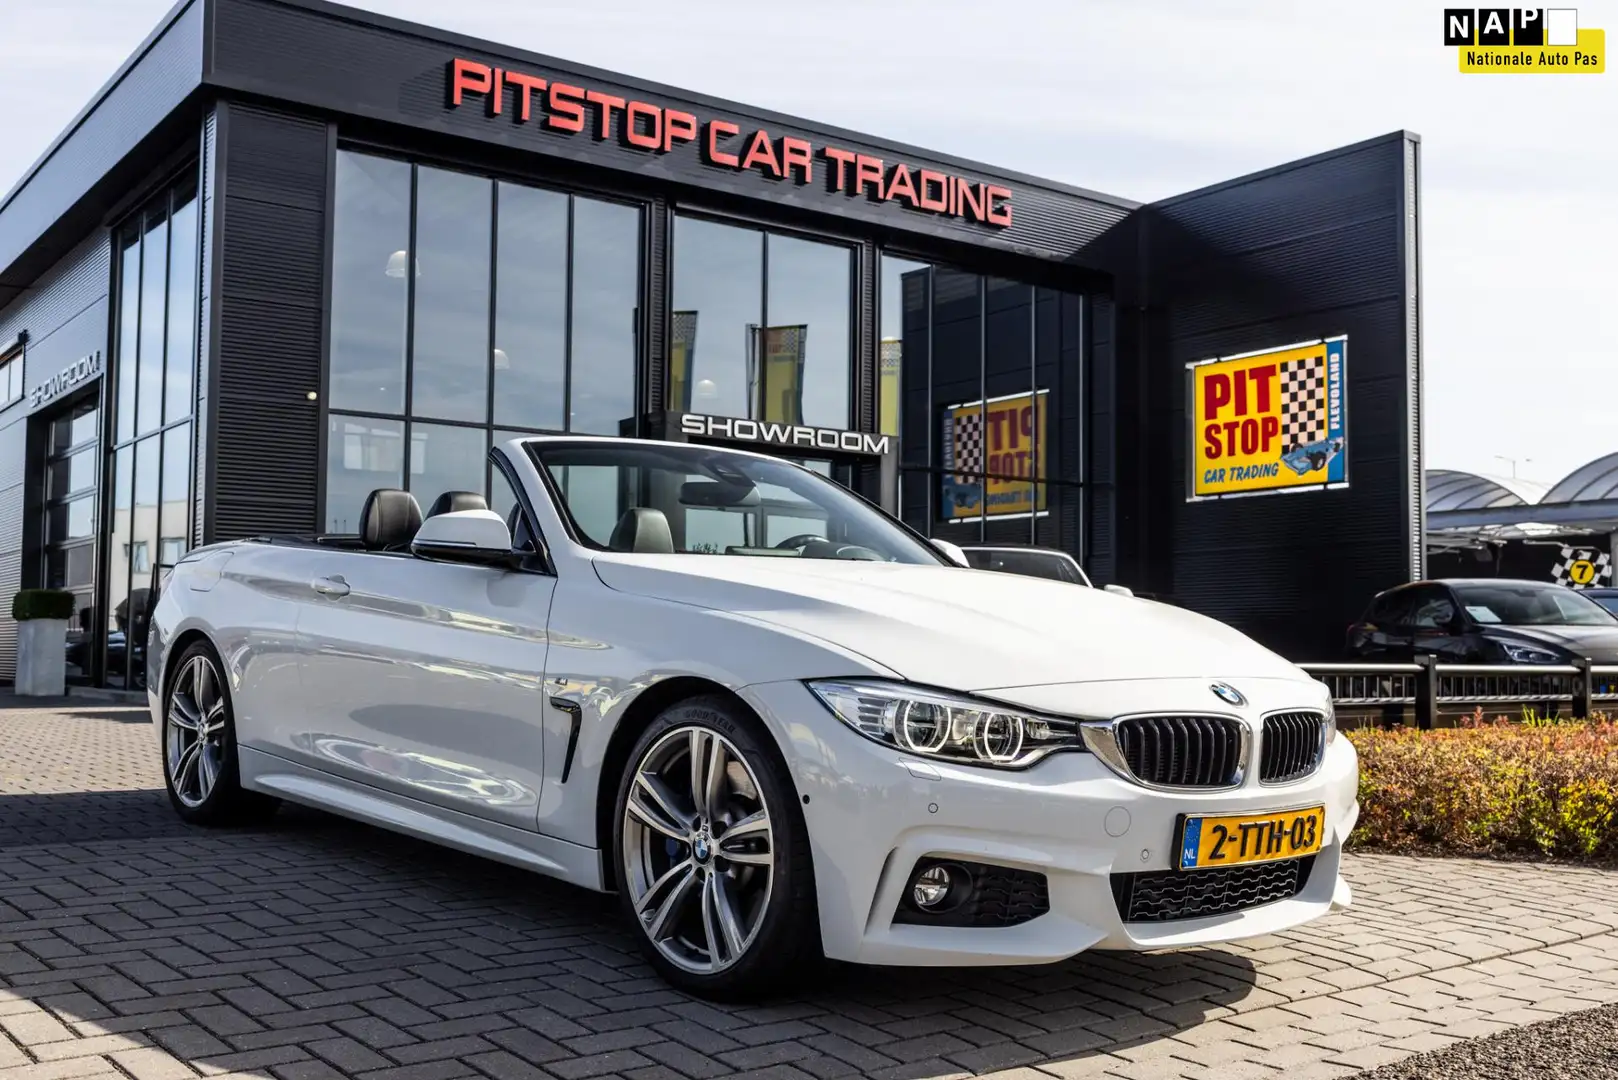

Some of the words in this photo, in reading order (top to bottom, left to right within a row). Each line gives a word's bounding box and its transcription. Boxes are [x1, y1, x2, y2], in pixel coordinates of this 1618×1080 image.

[449, 57, 697, 153] PITSTOP
[706, 119, 813, 184] CAR
[823, 146, 1013, 228] TRADING
[1204, 364, 1277, 421] PIT
[1330, 353, 1341, 430] FLEVOLAND
[681, 413, 889, 455] SHOWROOM
[1204, 416, 1279, 460] STOP
[1204, 467, 1227, 484] CAR
[1229, 462, 1280, 482] TRADING
[1575, 564, 1589, 580] 7
[1183, 848, 1196, 860] NL
[1208, 815, 1318, 860] 2-TTH-03
